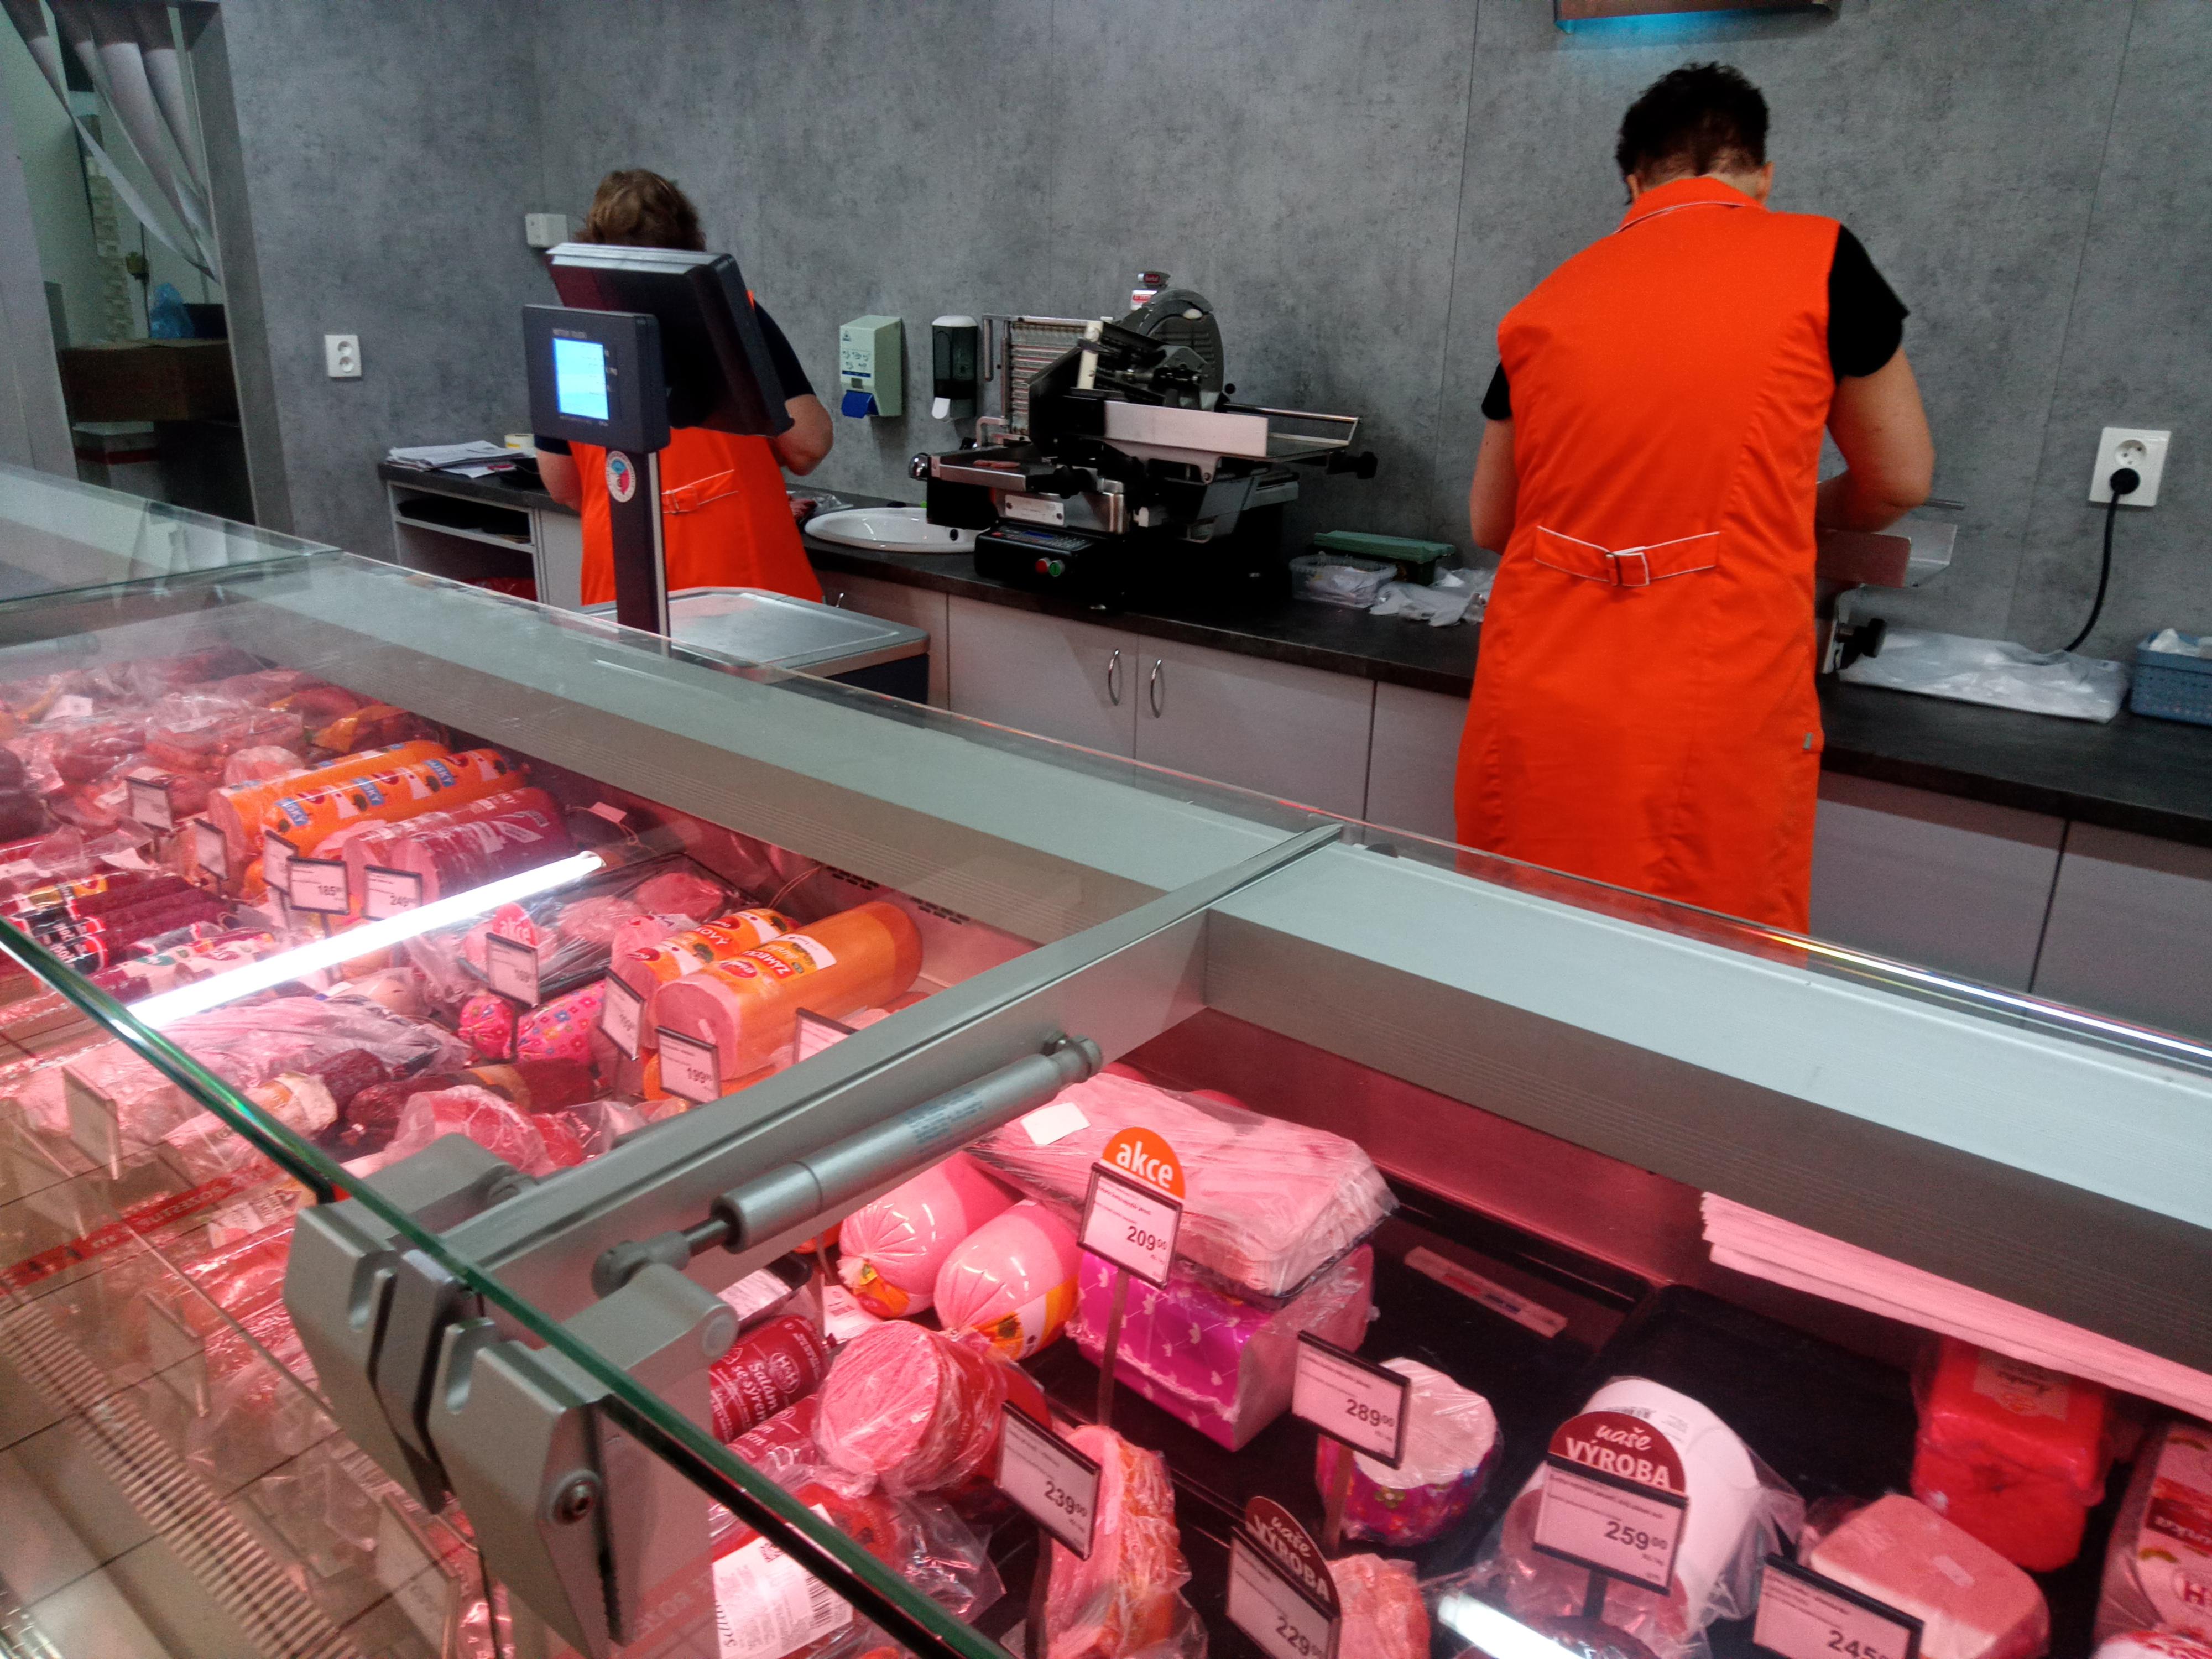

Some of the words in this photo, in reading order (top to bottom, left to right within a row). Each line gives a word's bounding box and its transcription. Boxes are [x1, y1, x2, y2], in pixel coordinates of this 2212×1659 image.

[1115, 1140, 1173, 1190] akce
[1126, 1225, 1156, 1251] 209
[1345, 1399, 1381, 1427] 289
[1595, 1423, 1653, 1451] naše
[1564, 1436, 1672, 1490] VÝROBA
[1044, 1480, 1075, 1515] 239
[1604, 1520, 1649, 1550] 259
[1245, 1514, 1331, 1603] VÝROBA
